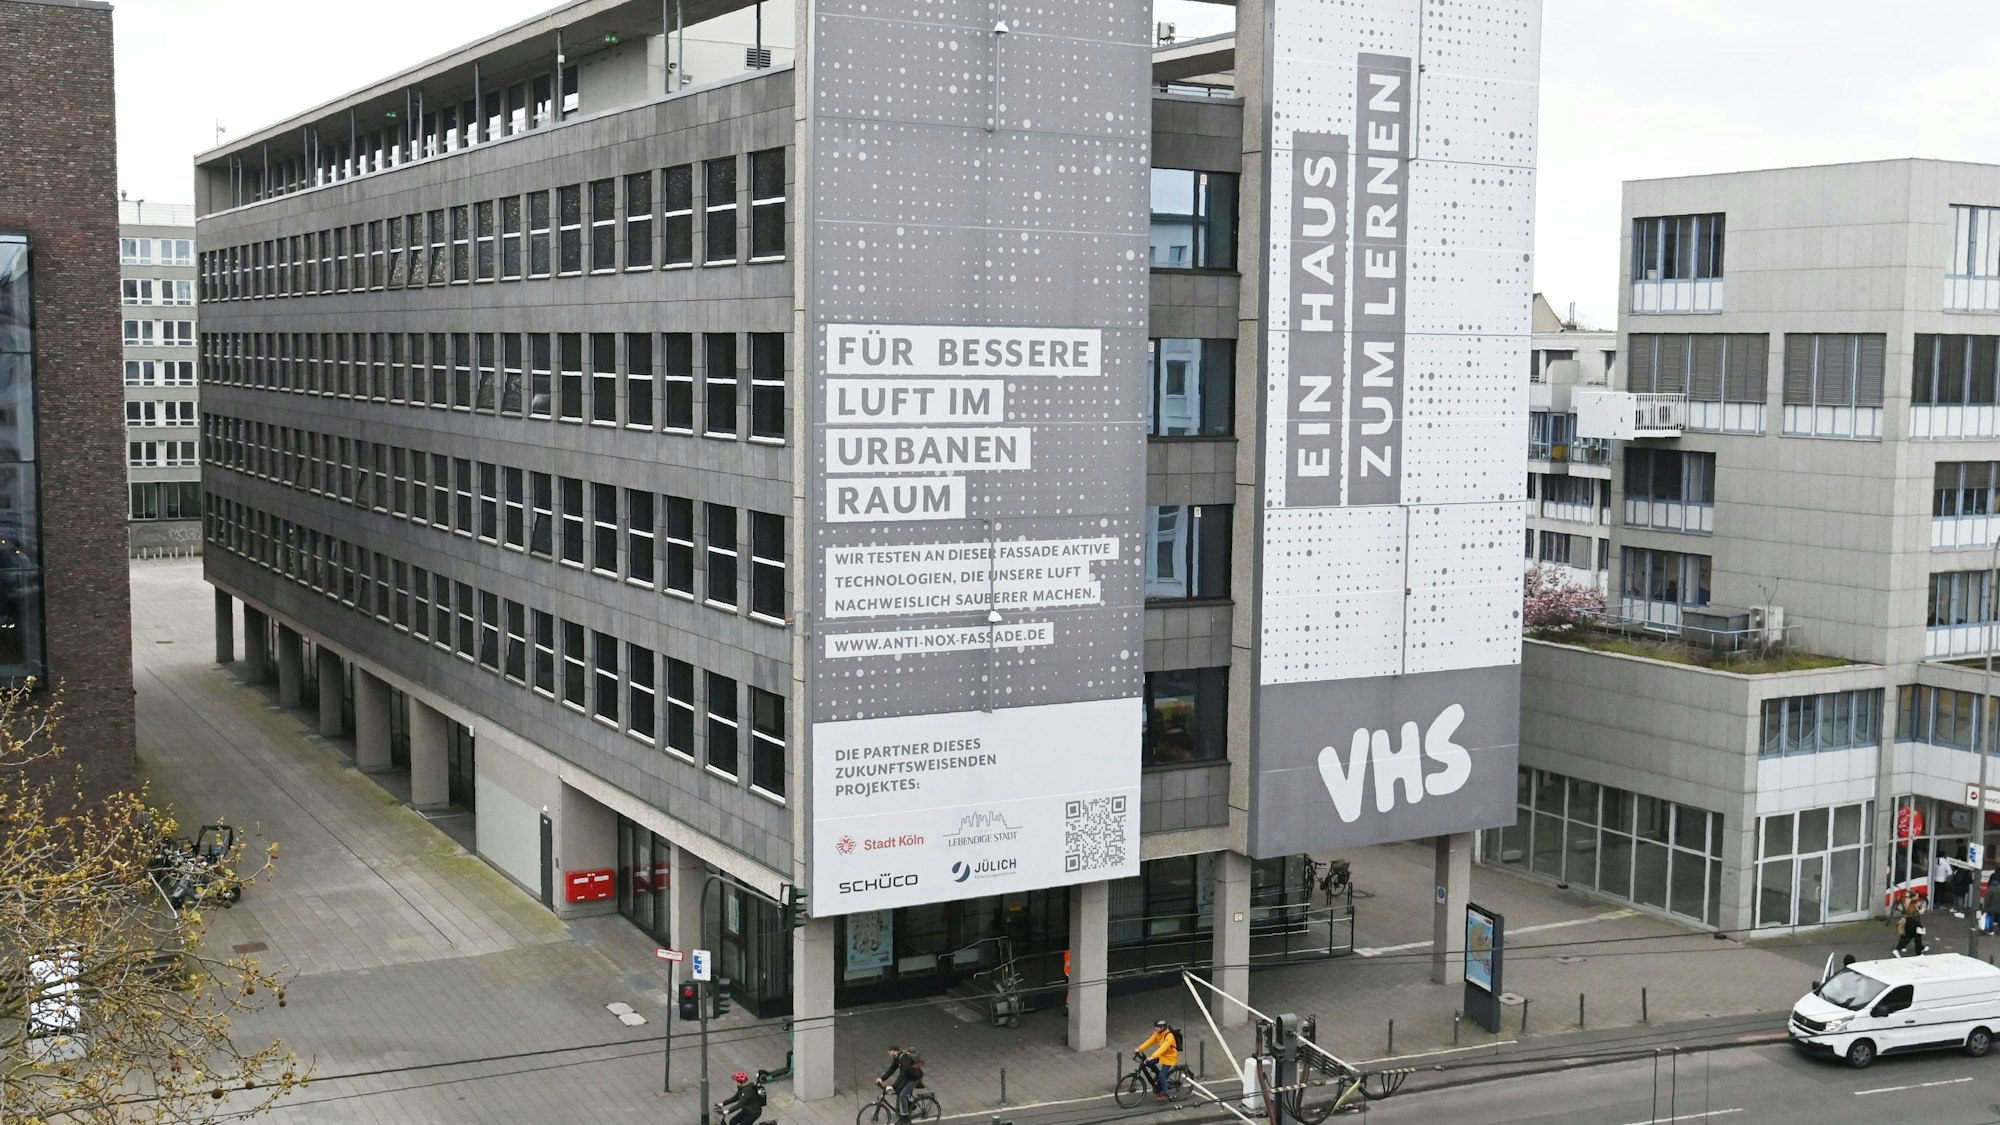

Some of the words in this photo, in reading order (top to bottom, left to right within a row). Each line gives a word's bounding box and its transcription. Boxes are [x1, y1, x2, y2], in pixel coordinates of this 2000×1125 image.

[1365, 74, 1401, 316] LERNEN
[1301, 156, 1337, 331] HAUS
[838, 329, 914, 366] FÜR
[938, 338, 1089, 368] BESSERE
[838, 387, 935, 416] LUFT
[949, 387, 990, 415] IM
[1360, 341, 1396, 477] ZUM
[1297, 376, 1332, 477] EIN
[838, 436, 1016, 465] URBANEN
[838, 484, 951, 515] RAUM
[835, 553, 864, 565] WIR
[867, 550, 921, 564] TESTEN
[924, 549, 945, 562] AN
[948, 547, 996, 561] DIESER
[1000, 545, 1059, 559] FASSADE
[1062, 543, 1110, 556] AKTIVE
[835, 572, 957, 589] TECHNOLOGIEN,
[960, 570, 984, 583] DIE
[988, 568, 1043, 582] UNSERE
[1047, 566, 1082, 579] LUFT
[835, 595, 951, 612] NACHWEISLICH
[955, 590, 1028, 606] SAUBERER
[1032, 587, 1096, 602] MACHEN.
[835, 629, 1046, 652] WWW.ANTI-NOX-FASSADE.DE
[835, 748, 860, 761] DIE
[863, 742, 930, 759] PARTNER
[932, 737, 982, 753] DIESES
[835, 753, 997, 779] ZUKUNFTSWEISENDEN
[1317, 703, 1472, 823] VHS
[835, 778, 921, 797] PROJEKTES:
[864, 837, 897, 851] Stadt
[899, 834, 924, 847] Köln
[948, 833, 993, 847] LEBENDIGE
[993, 831, 1018, 842] STADT
[974, 858, 1017, 873] JÜLICH
[839, 873, 919, 894] SCHÜCO
